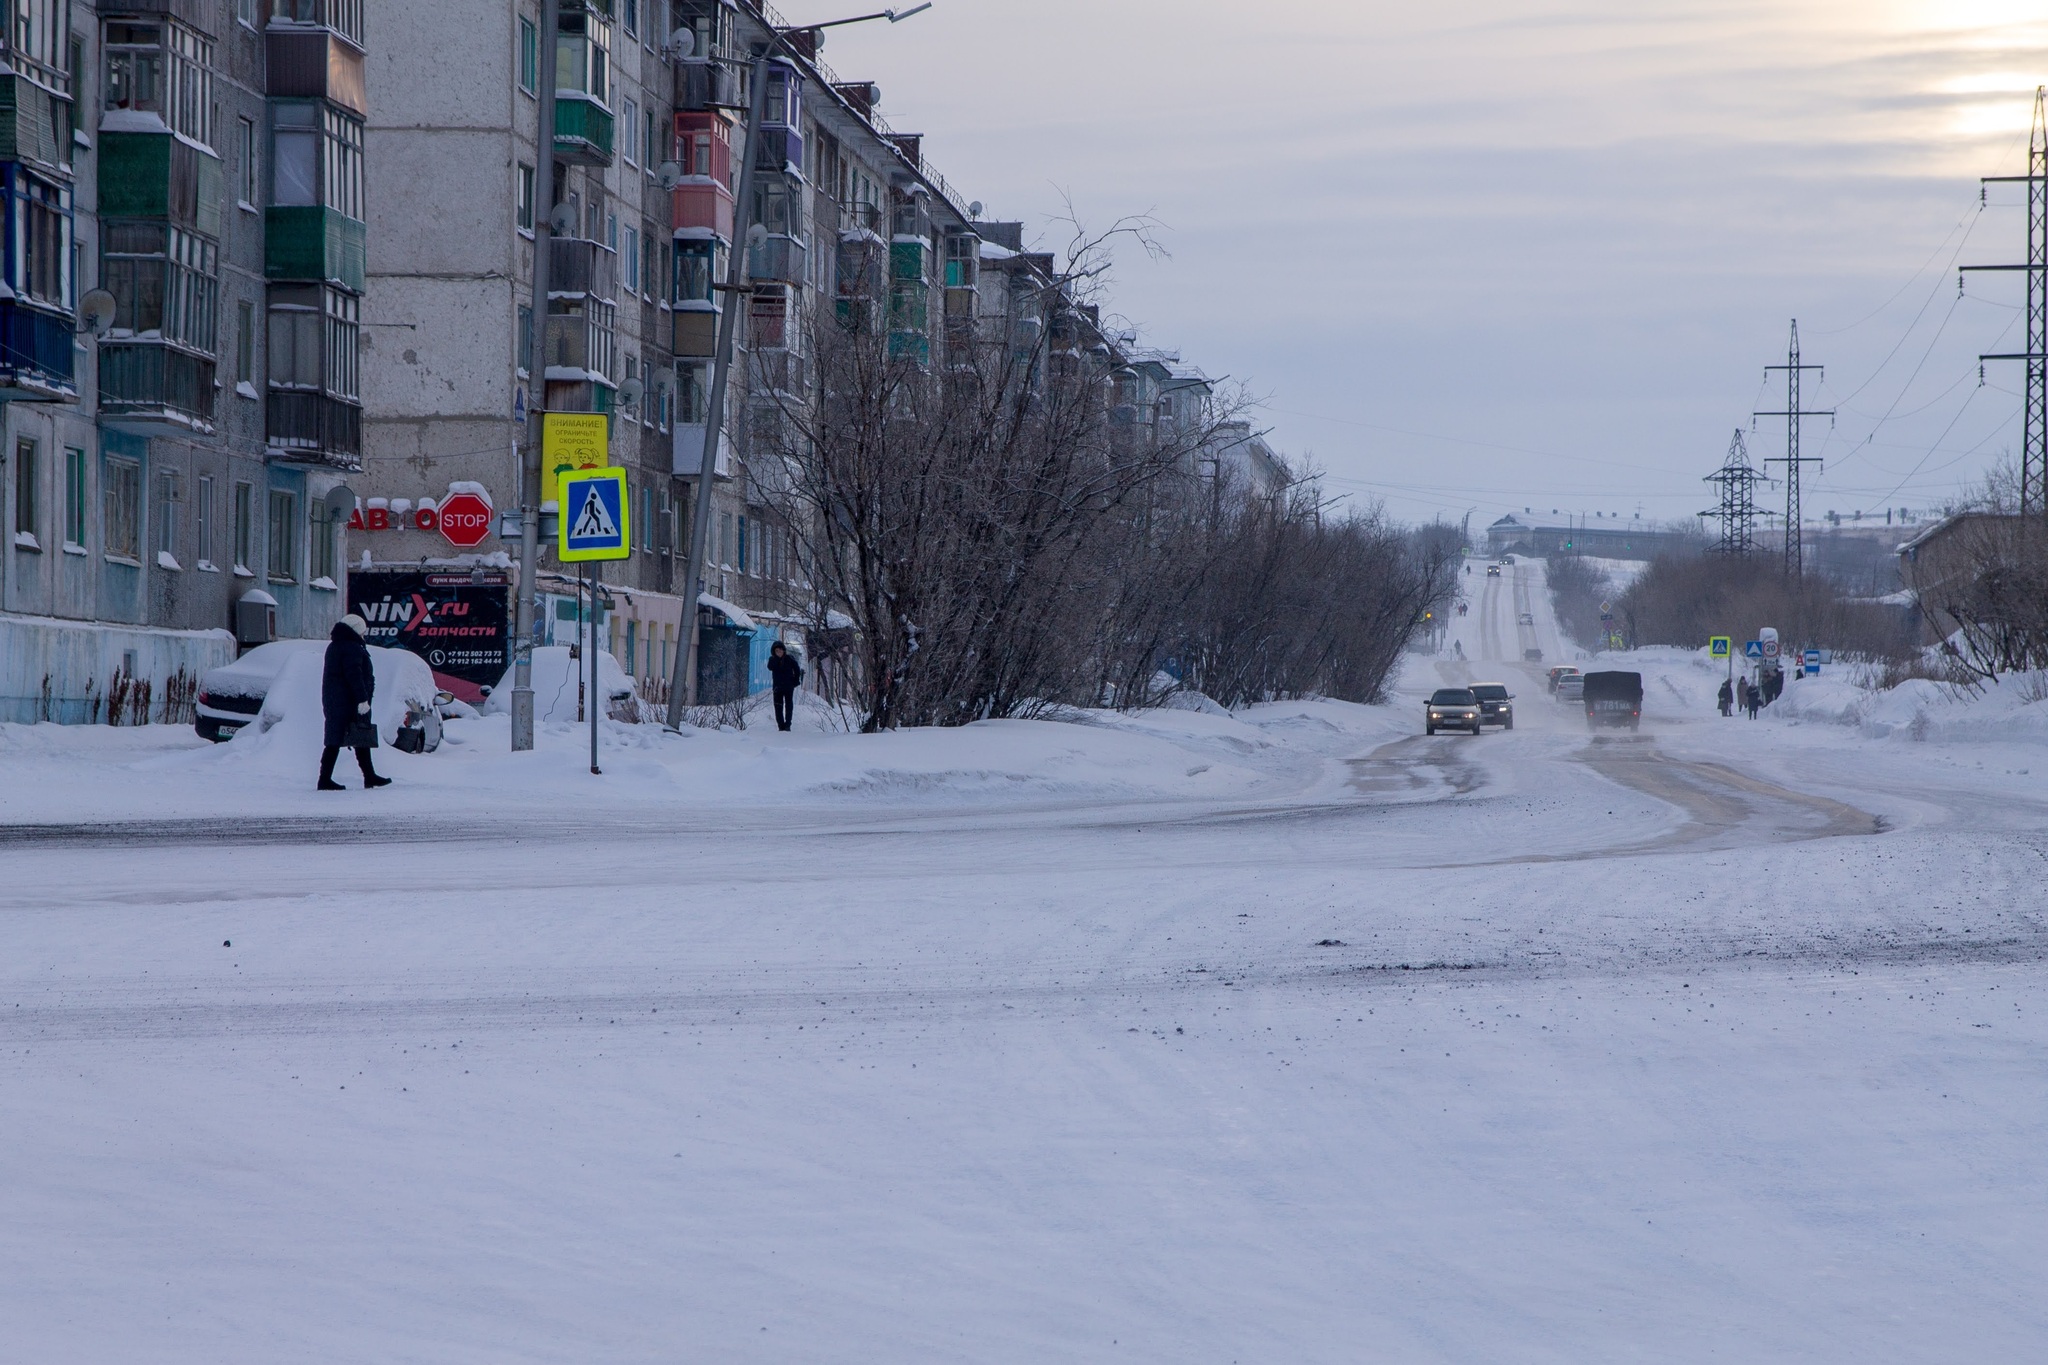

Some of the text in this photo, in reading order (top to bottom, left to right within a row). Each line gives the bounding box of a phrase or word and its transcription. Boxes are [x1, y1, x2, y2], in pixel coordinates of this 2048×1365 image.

[550, 419, 603, 428] ВНИМАНИЕ!
[555, 429, 597, 437] ОГРАНИЧЬТЕ
[444, 514, 487, 527] STOP
[418, 627, 496, 636] запчасти
